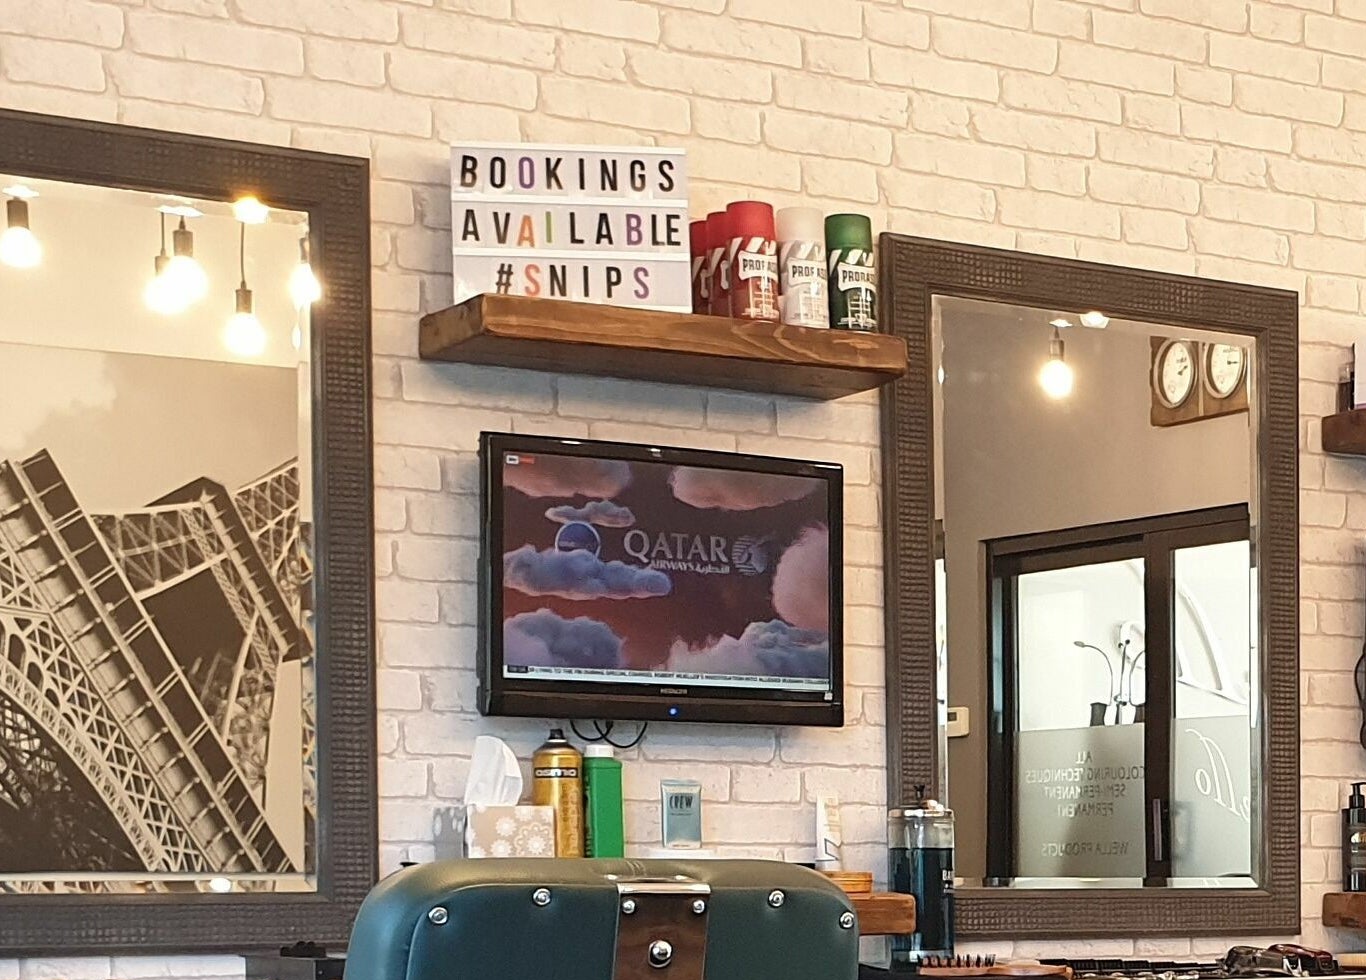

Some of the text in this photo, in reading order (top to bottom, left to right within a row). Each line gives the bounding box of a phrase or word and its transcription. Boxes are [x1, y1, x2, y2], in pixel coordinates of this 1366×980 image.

[460, 154, 675, 193] BOOKINGS
[461, 208, 682, 249] AVAILABLE
[495, 262, 650, 299] #SNIPS
[623, 529, 729, 563] QATAR
[669, 795, 693, 810] CREW
